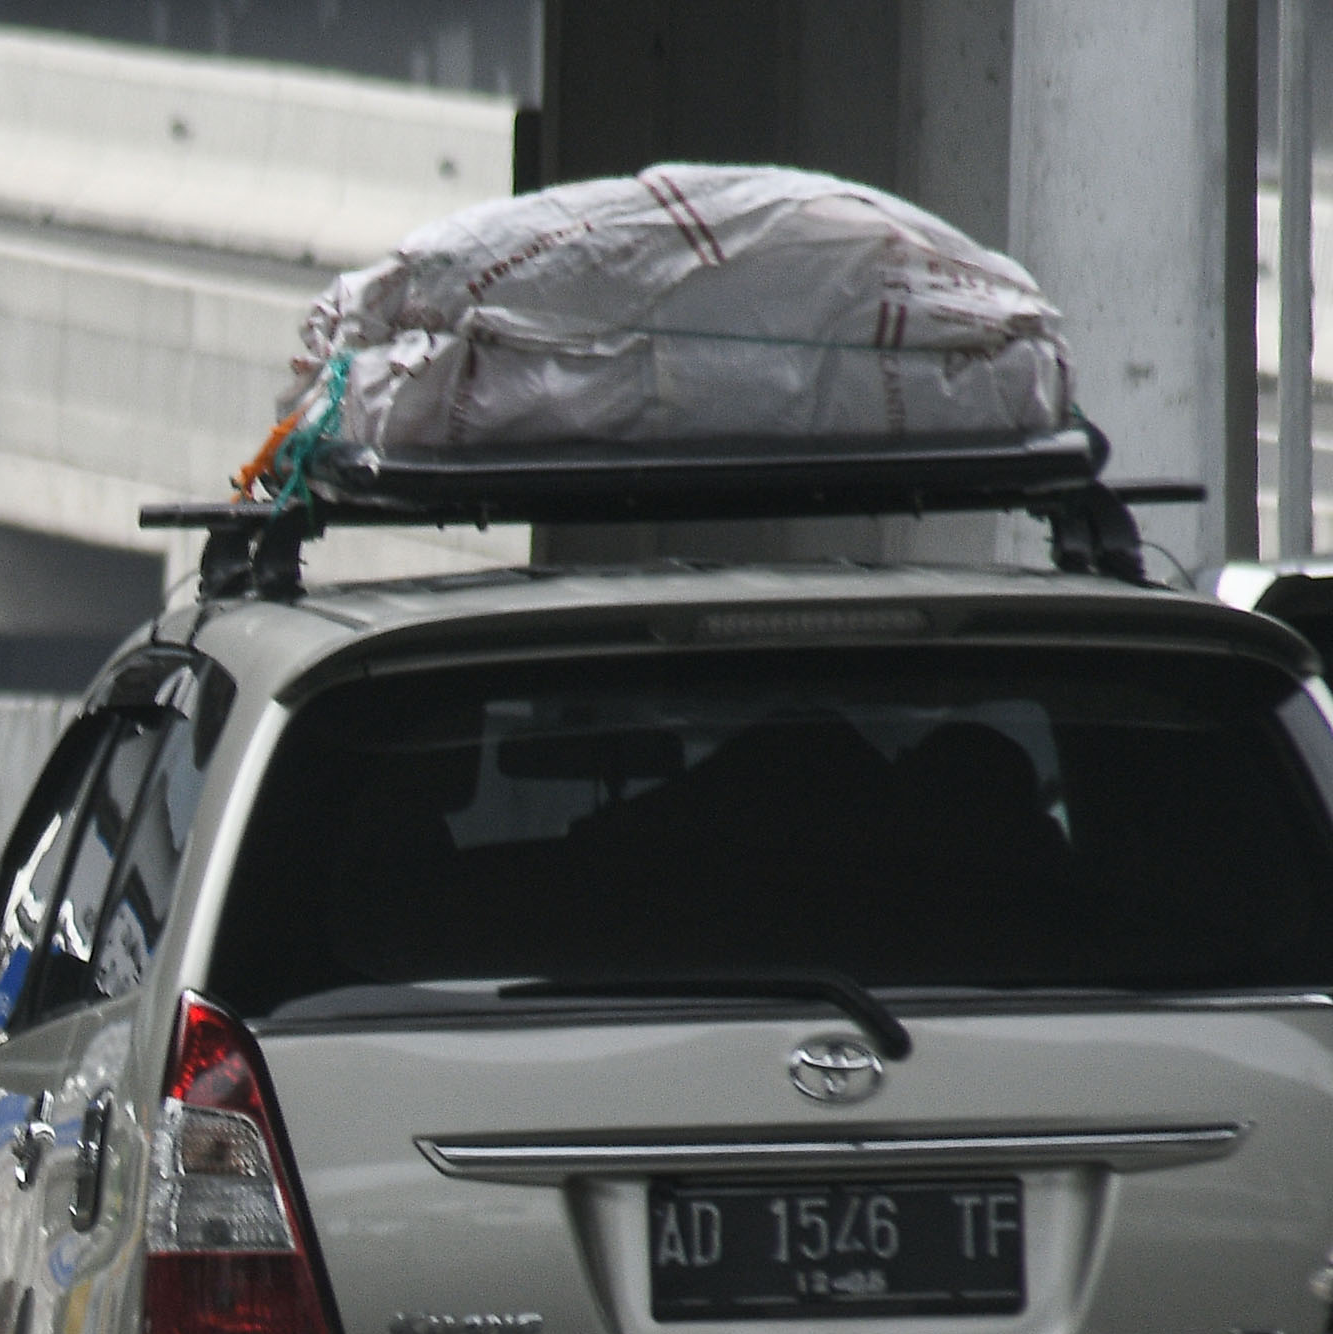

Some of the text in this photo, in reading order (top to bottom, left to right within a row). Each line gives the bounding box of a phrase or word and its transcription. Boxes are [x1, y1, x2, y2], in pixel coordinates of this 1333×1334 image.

[658, 1193, 1018, 1266] AD 1546 TF
